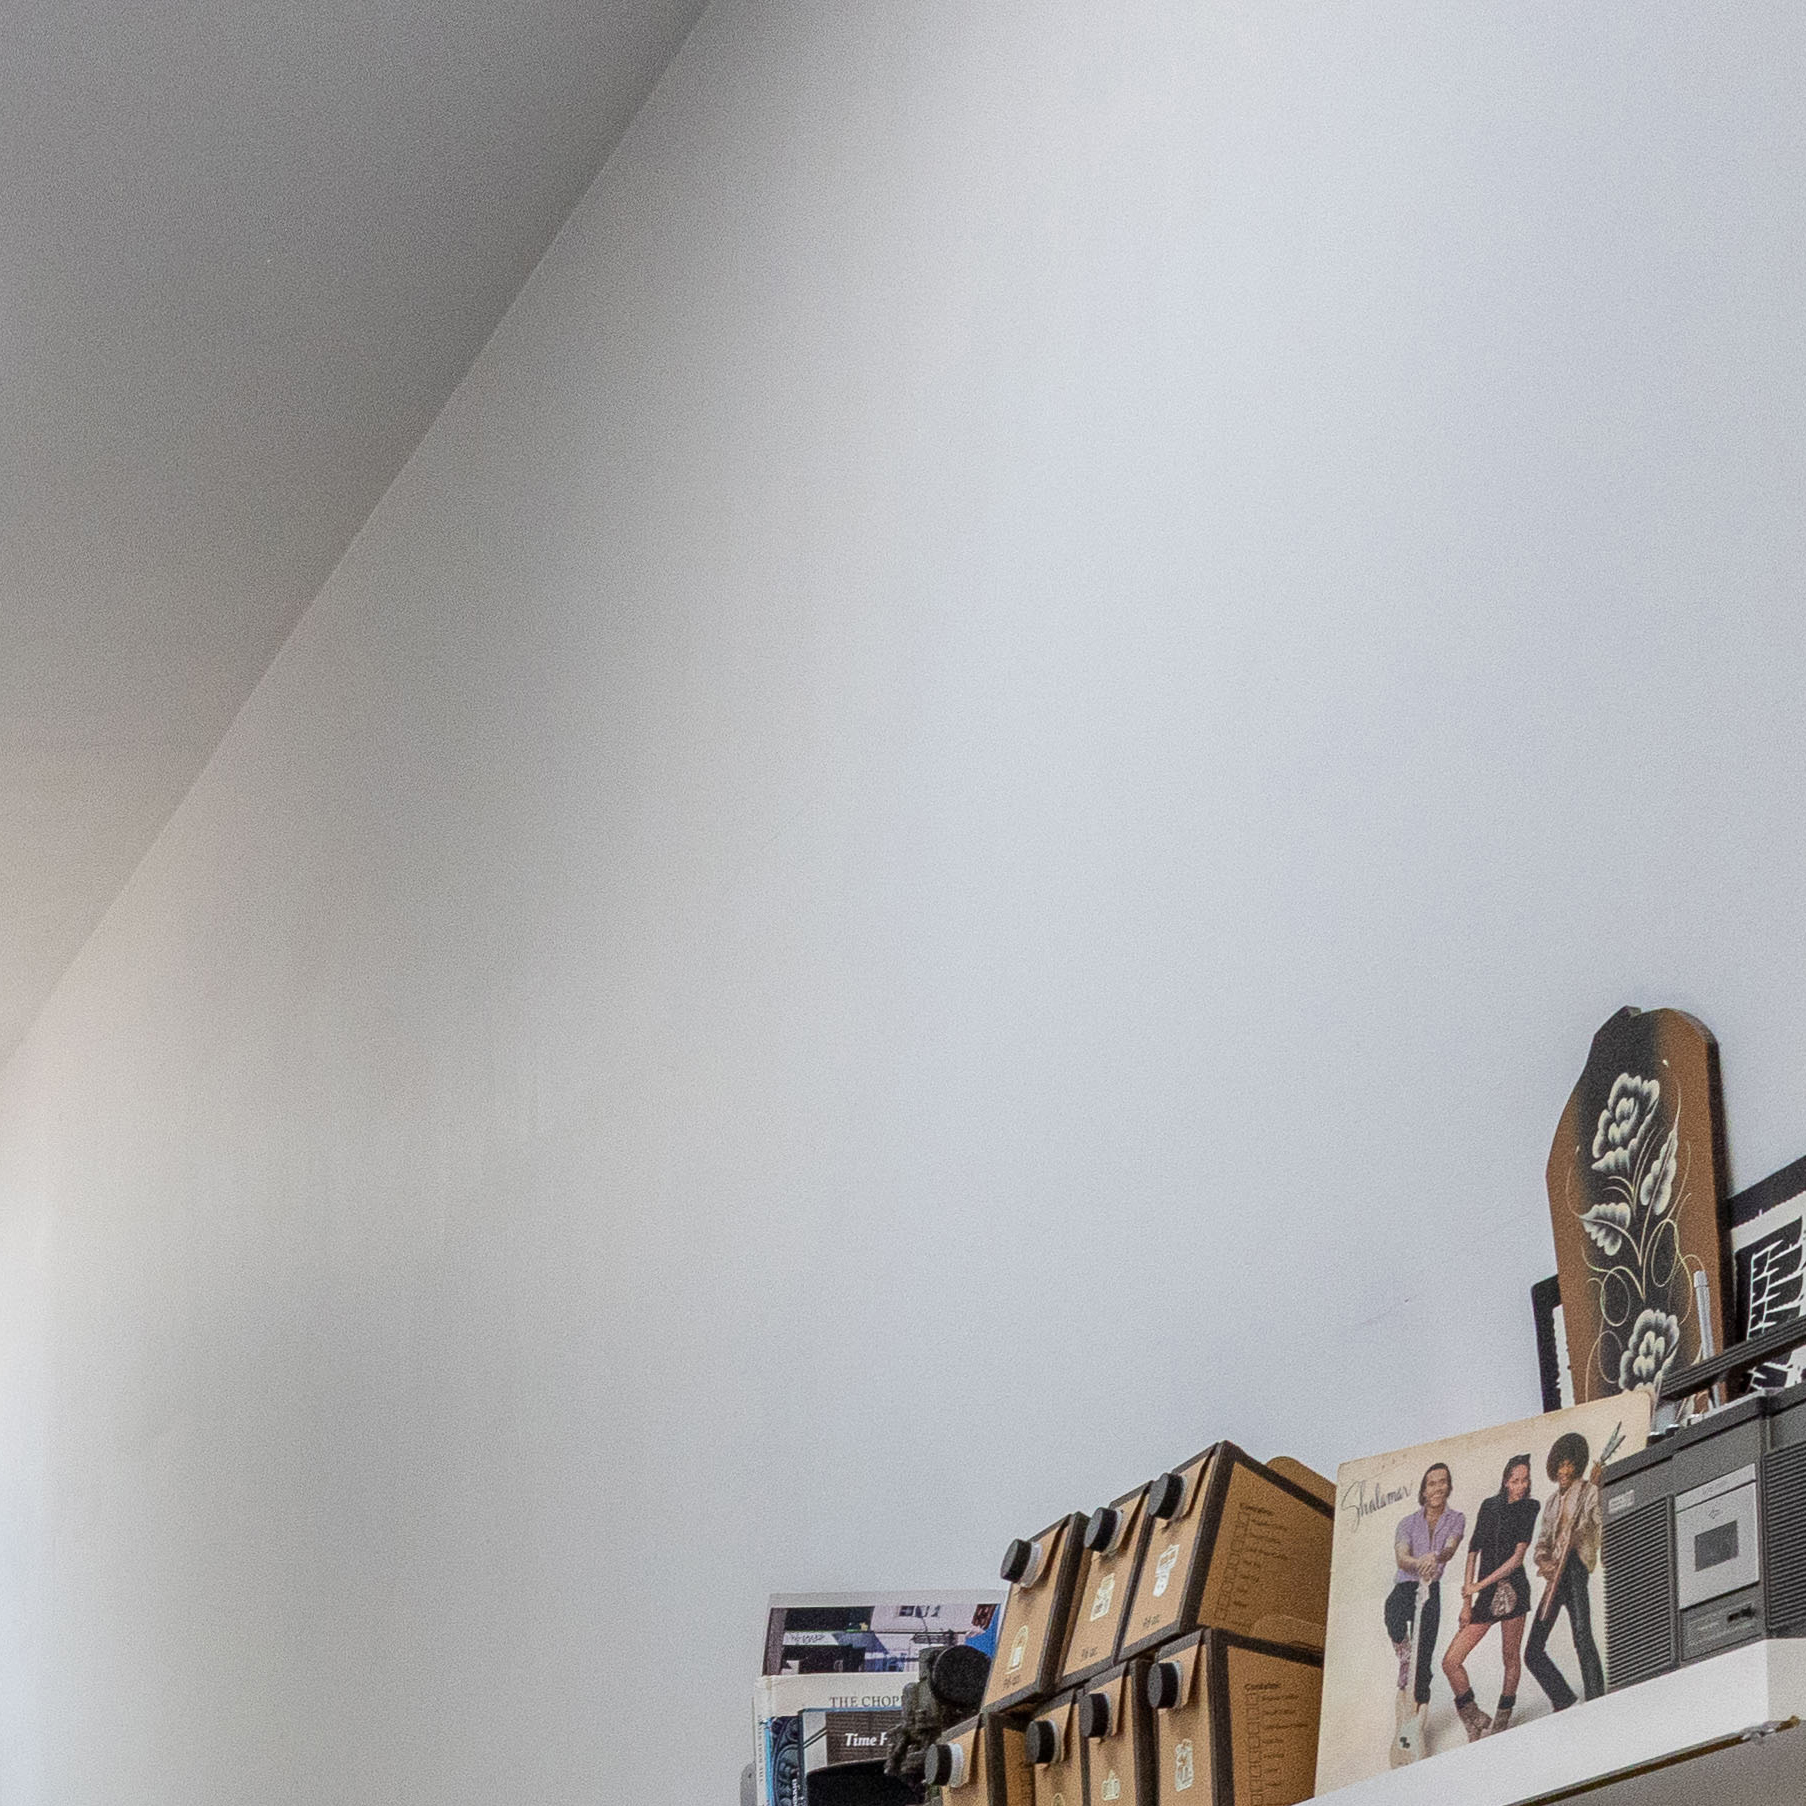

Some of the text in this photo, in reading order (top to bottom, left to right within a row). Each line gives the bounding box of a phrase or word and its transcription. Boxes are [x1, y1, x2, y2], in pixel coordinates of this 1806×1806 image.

[1341, 1480, 1413, 1533] Shalamar
[830, 1696, 858, 1708] THE
[844, 1732, 888, 1748] Time F
